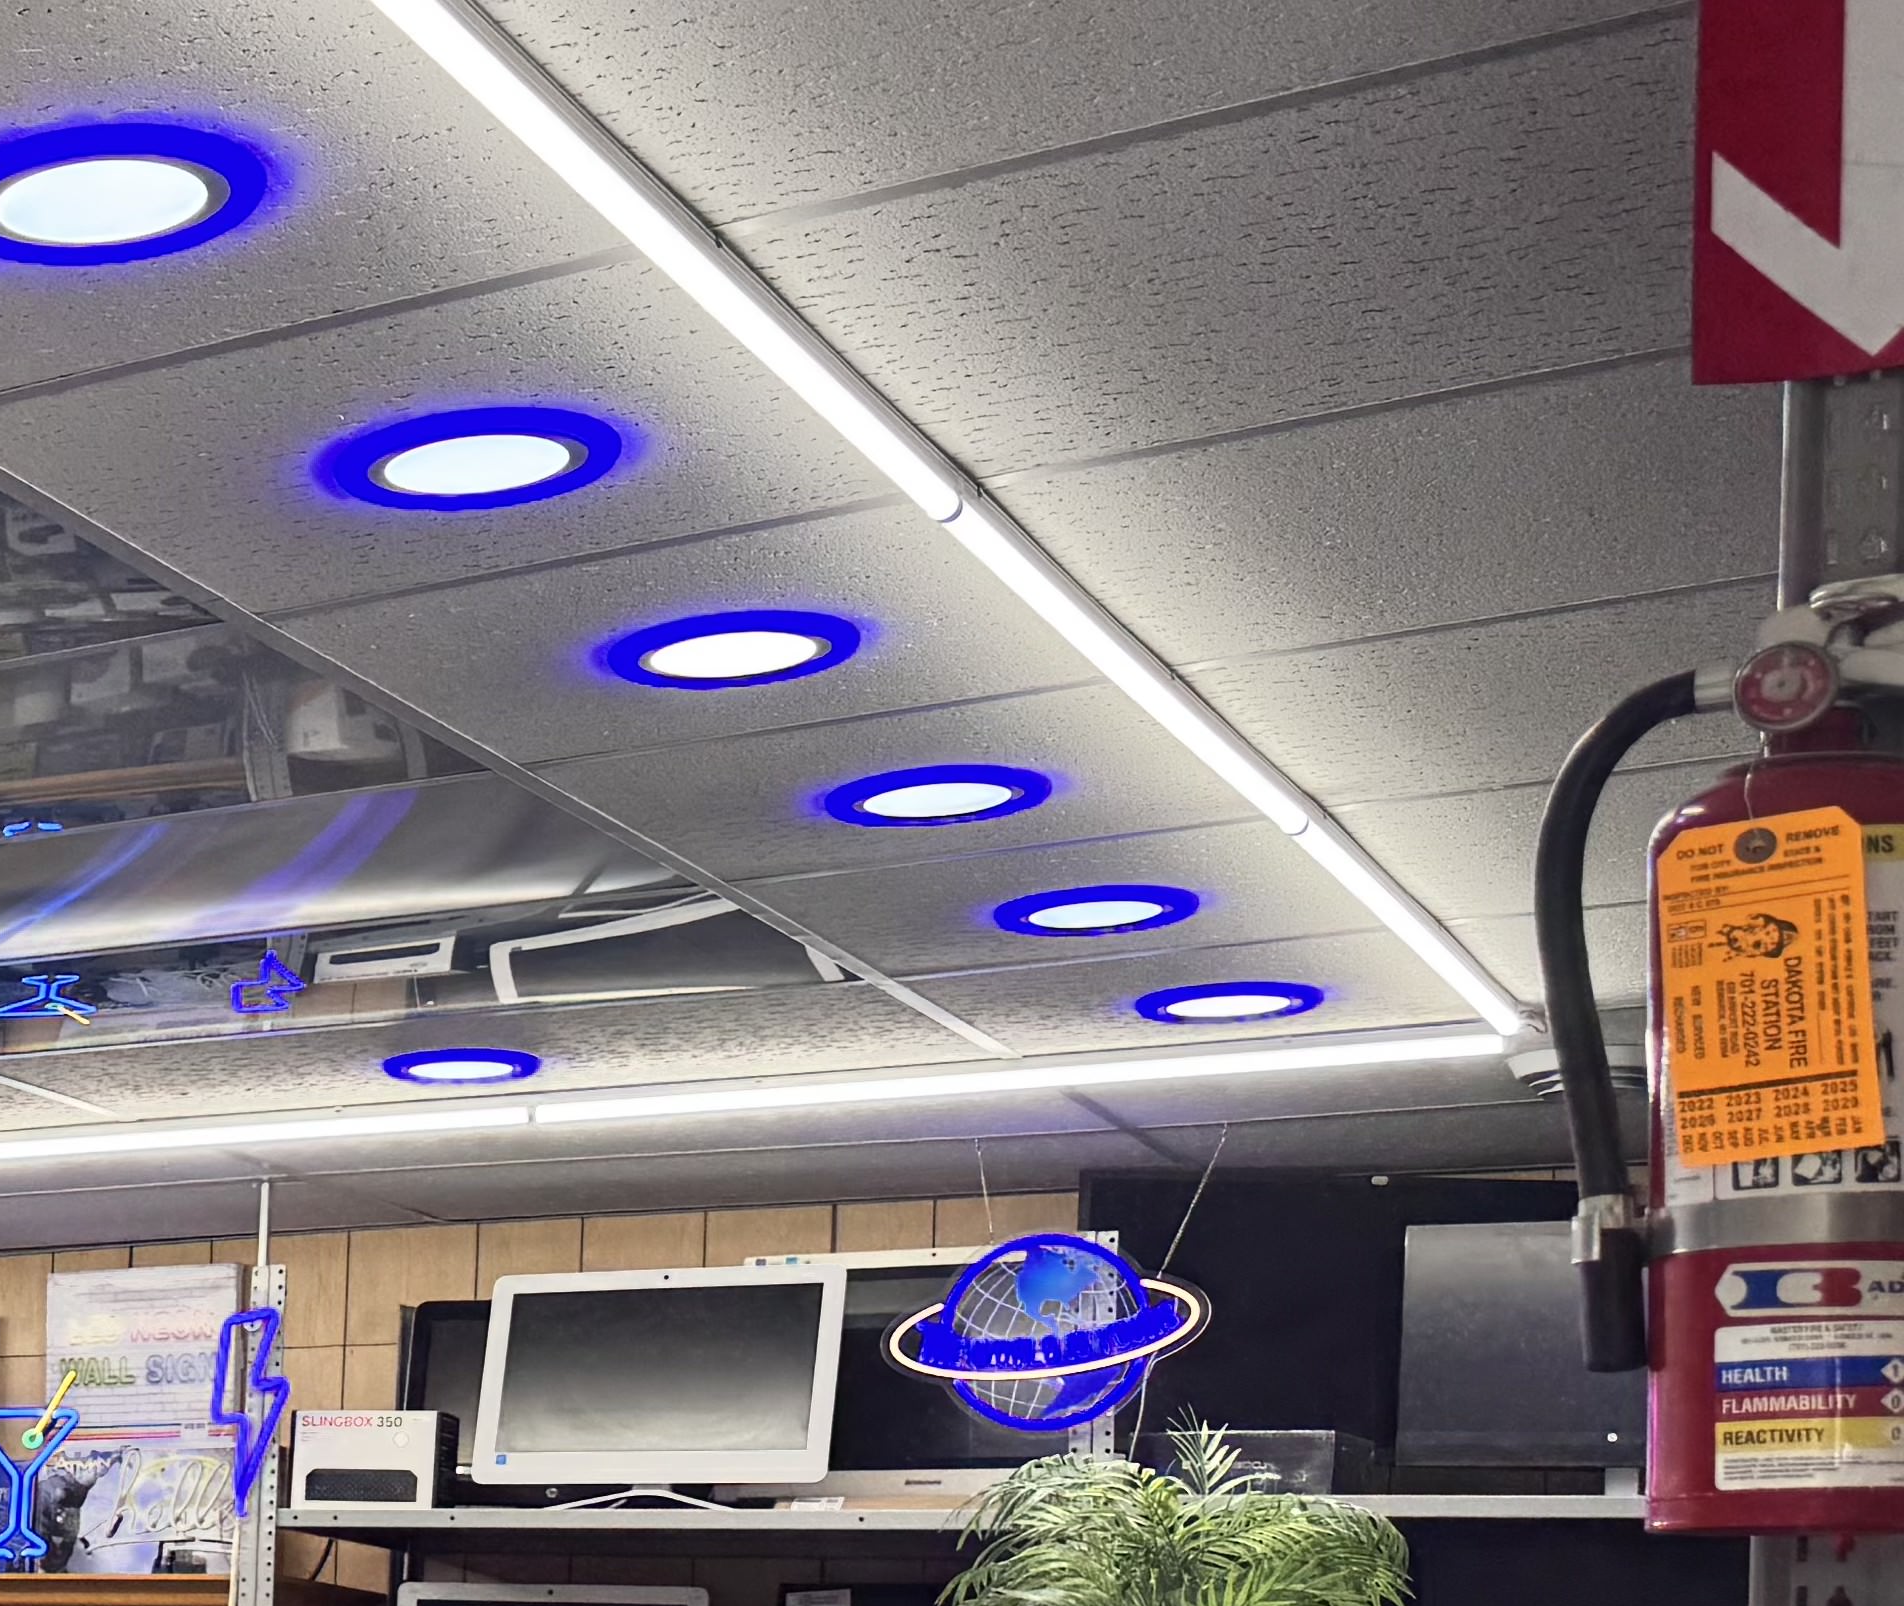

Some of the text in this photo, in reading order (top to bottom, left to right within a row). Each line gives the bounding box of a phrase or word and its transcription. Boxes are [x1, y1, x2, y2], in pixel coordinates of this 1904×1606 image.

[1785, 825, 1840, 842] REMOVE
[1740, 970, 1761, 1068] 701-222-0242
[1760, 978, 1783, 1051] STATION
[1783, 956, 1808, 1068] DAKOTA FIRE
[1679, 1079, 1858, 1113] 2022 2023 2024 2025
[1727, 1108, 1762, 1124] 2027
[59, 1352, 218, 1386] WALL SIGN
[1721, 1366, 1788, 1384] HEALTH
[1721, 1394, 1857, 1414] FLAMMABILITY
[301, 1415, 403, 1428] SLINGBOX 350
[1722, 1428, 1825, 1446] REACTIVITY
